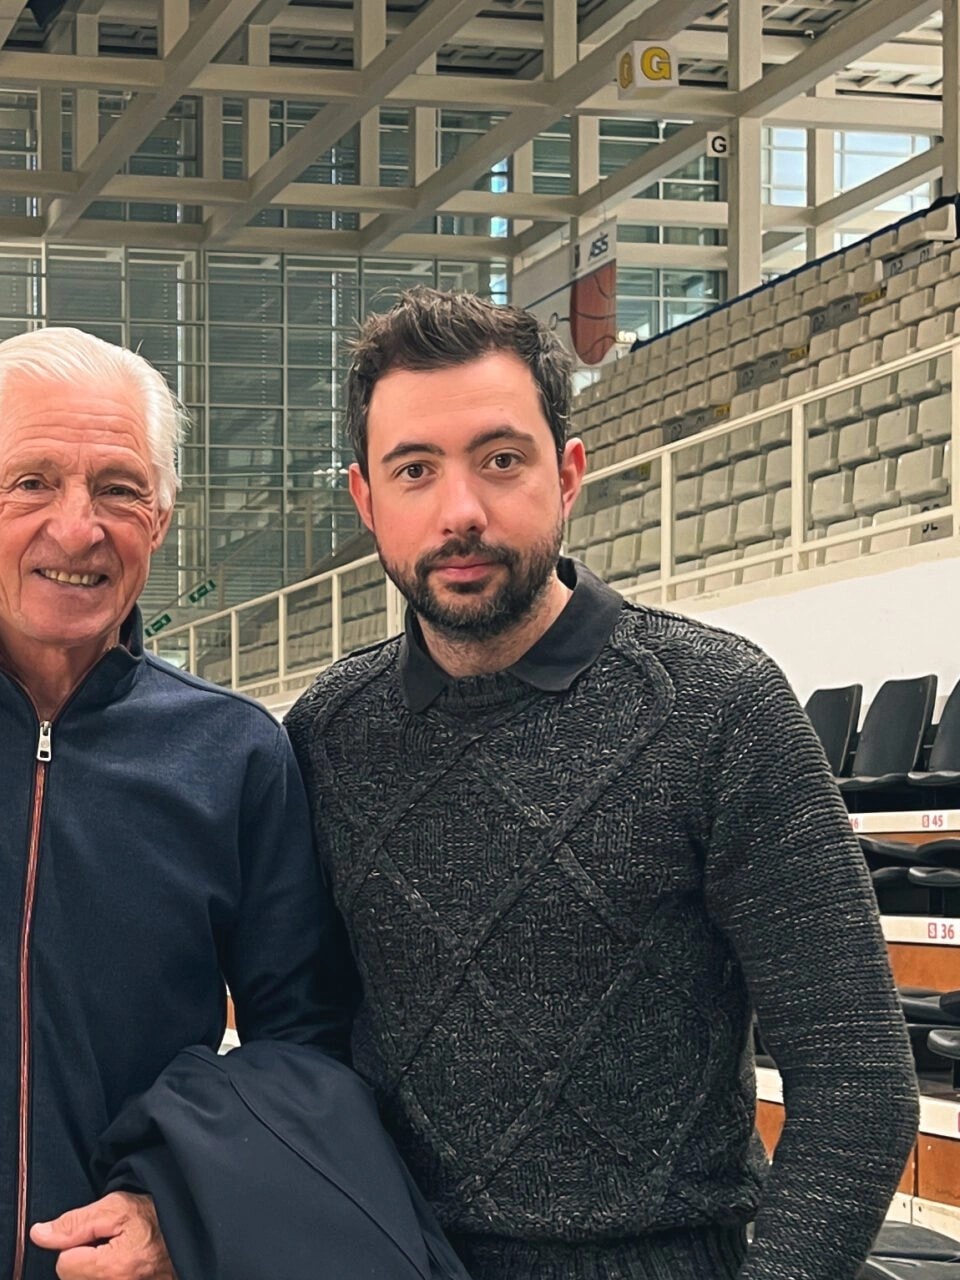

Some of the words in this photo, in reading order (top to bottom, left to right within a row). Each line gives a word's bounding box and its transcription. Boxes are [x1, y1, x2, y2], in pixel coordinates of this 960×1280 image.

[640, 46, 672, 81] G
[711, 136, 727, 153] G
[932, 814, 943, 828] 45
[941, 923, 954, 939] 36
